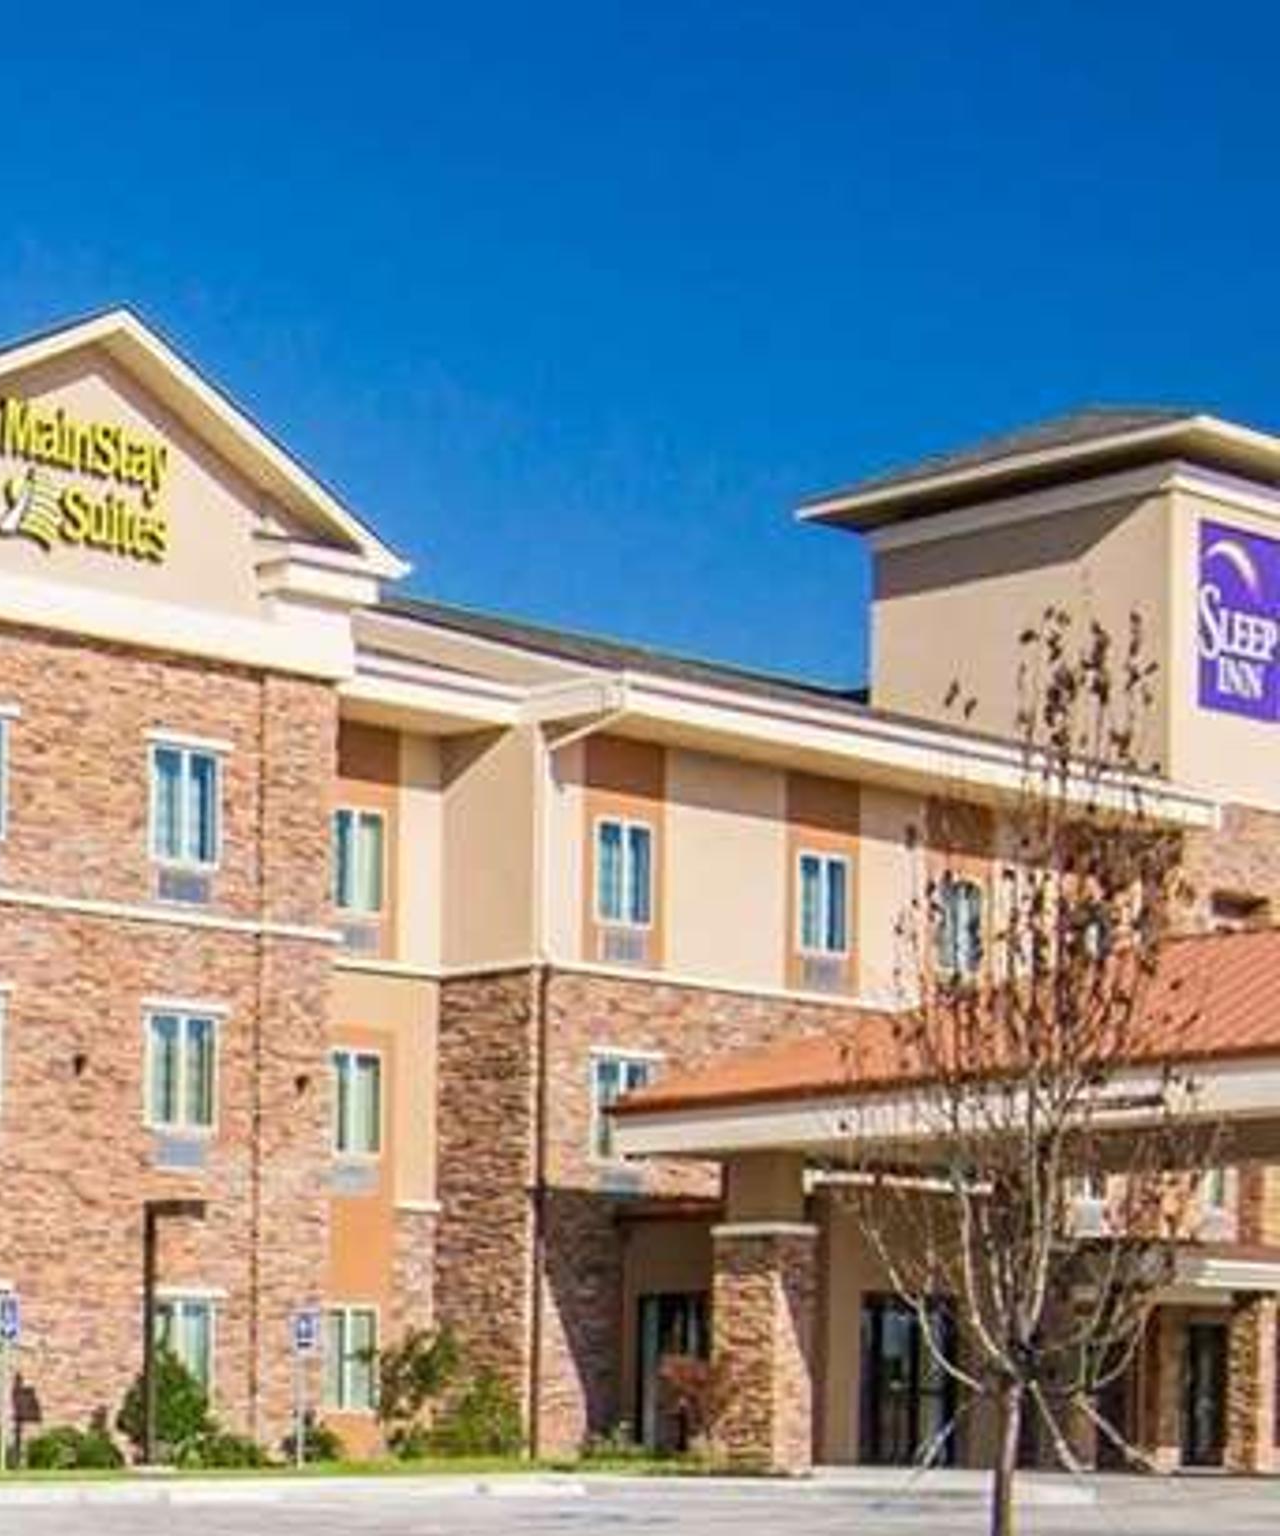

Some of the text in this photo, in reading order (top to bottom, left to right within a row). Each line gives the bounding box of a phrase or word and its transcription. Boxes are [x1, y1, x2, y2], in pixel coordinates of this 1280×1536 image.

[59, 489, 166, 562] Suites
[1199, 584, 1276, 661] SLEEP
[1218, 656, 1263, 699] INN
